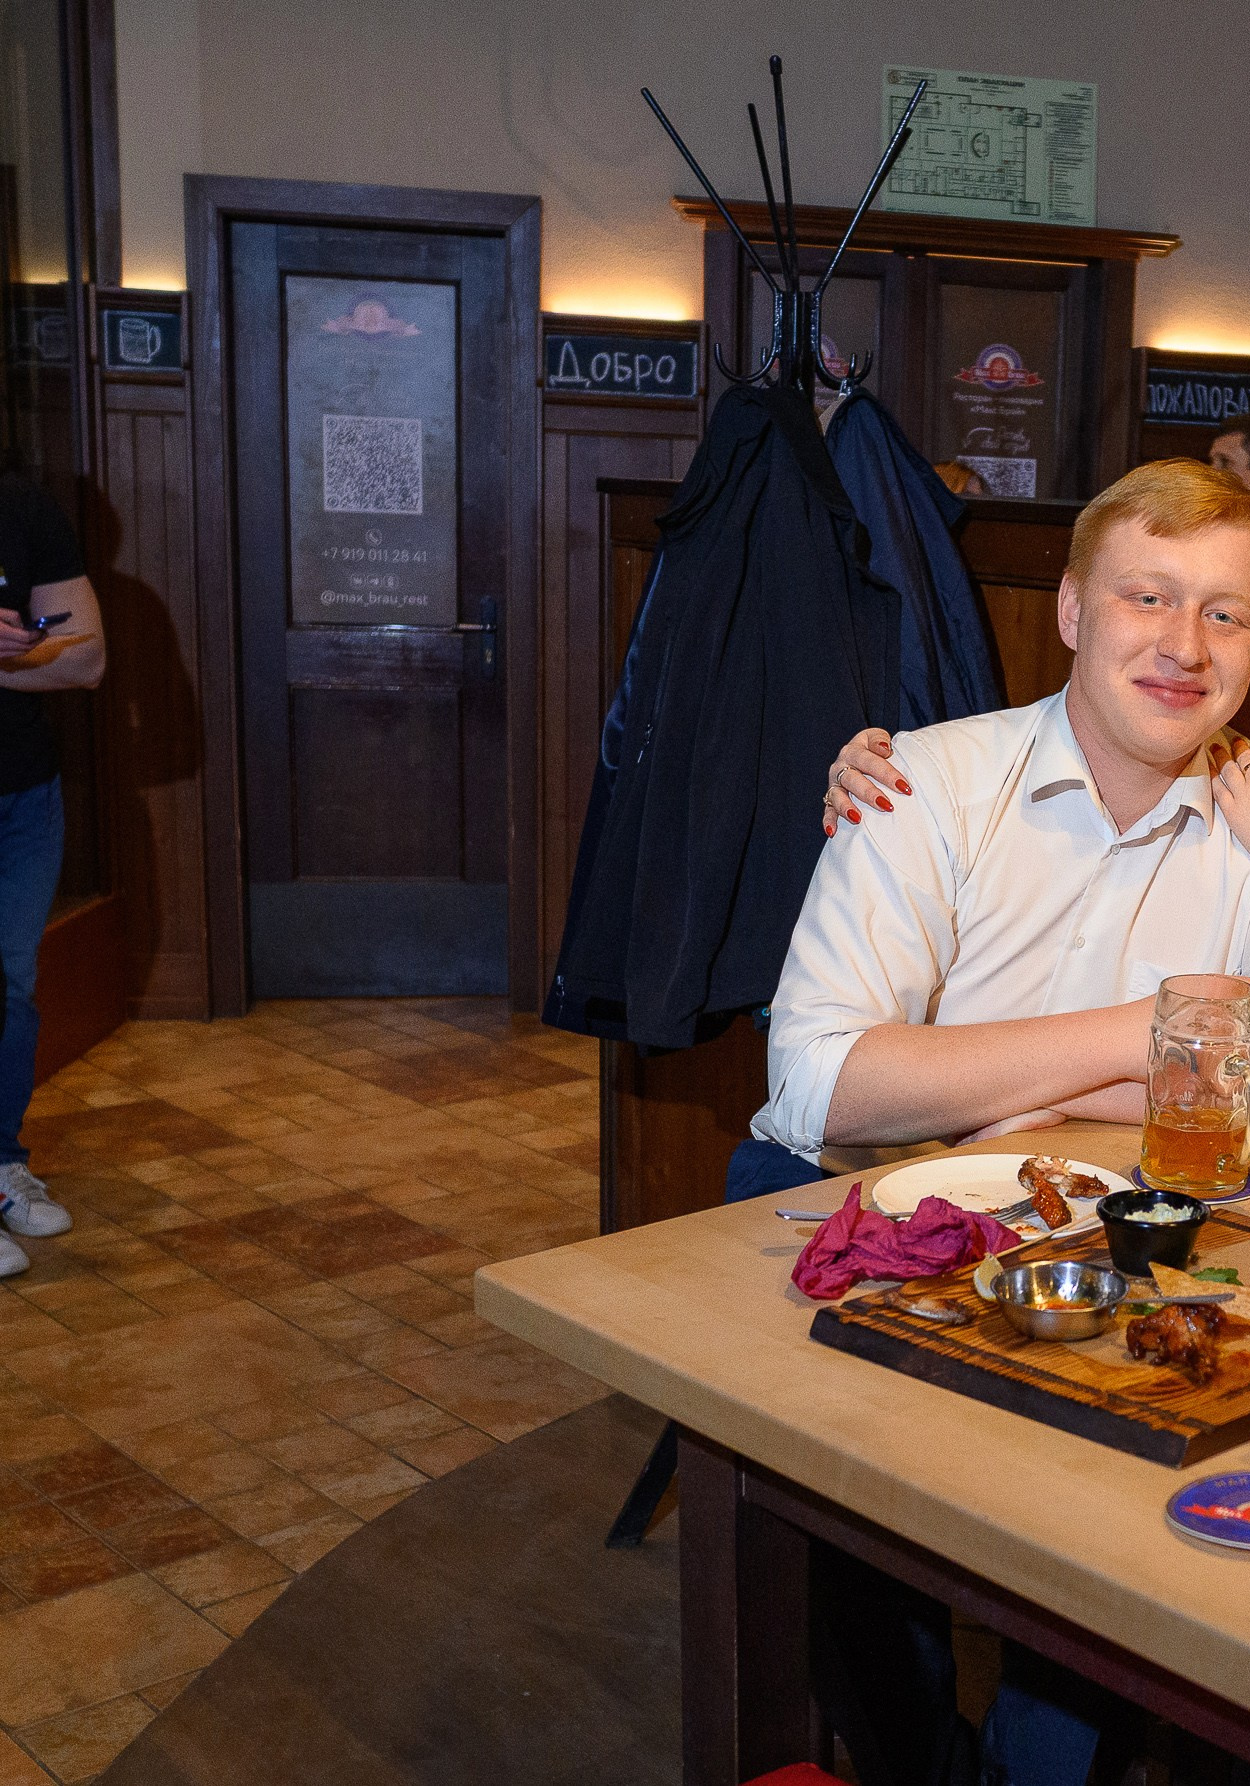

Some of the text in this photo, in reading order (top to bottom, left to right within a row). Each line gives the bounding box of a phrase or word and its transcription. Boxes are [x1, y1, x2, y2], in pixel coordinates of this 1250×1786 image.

[321, 547, 427, 562] +7 919 011 28 41
[320, 590, 428, 607] @max_brau_rest
